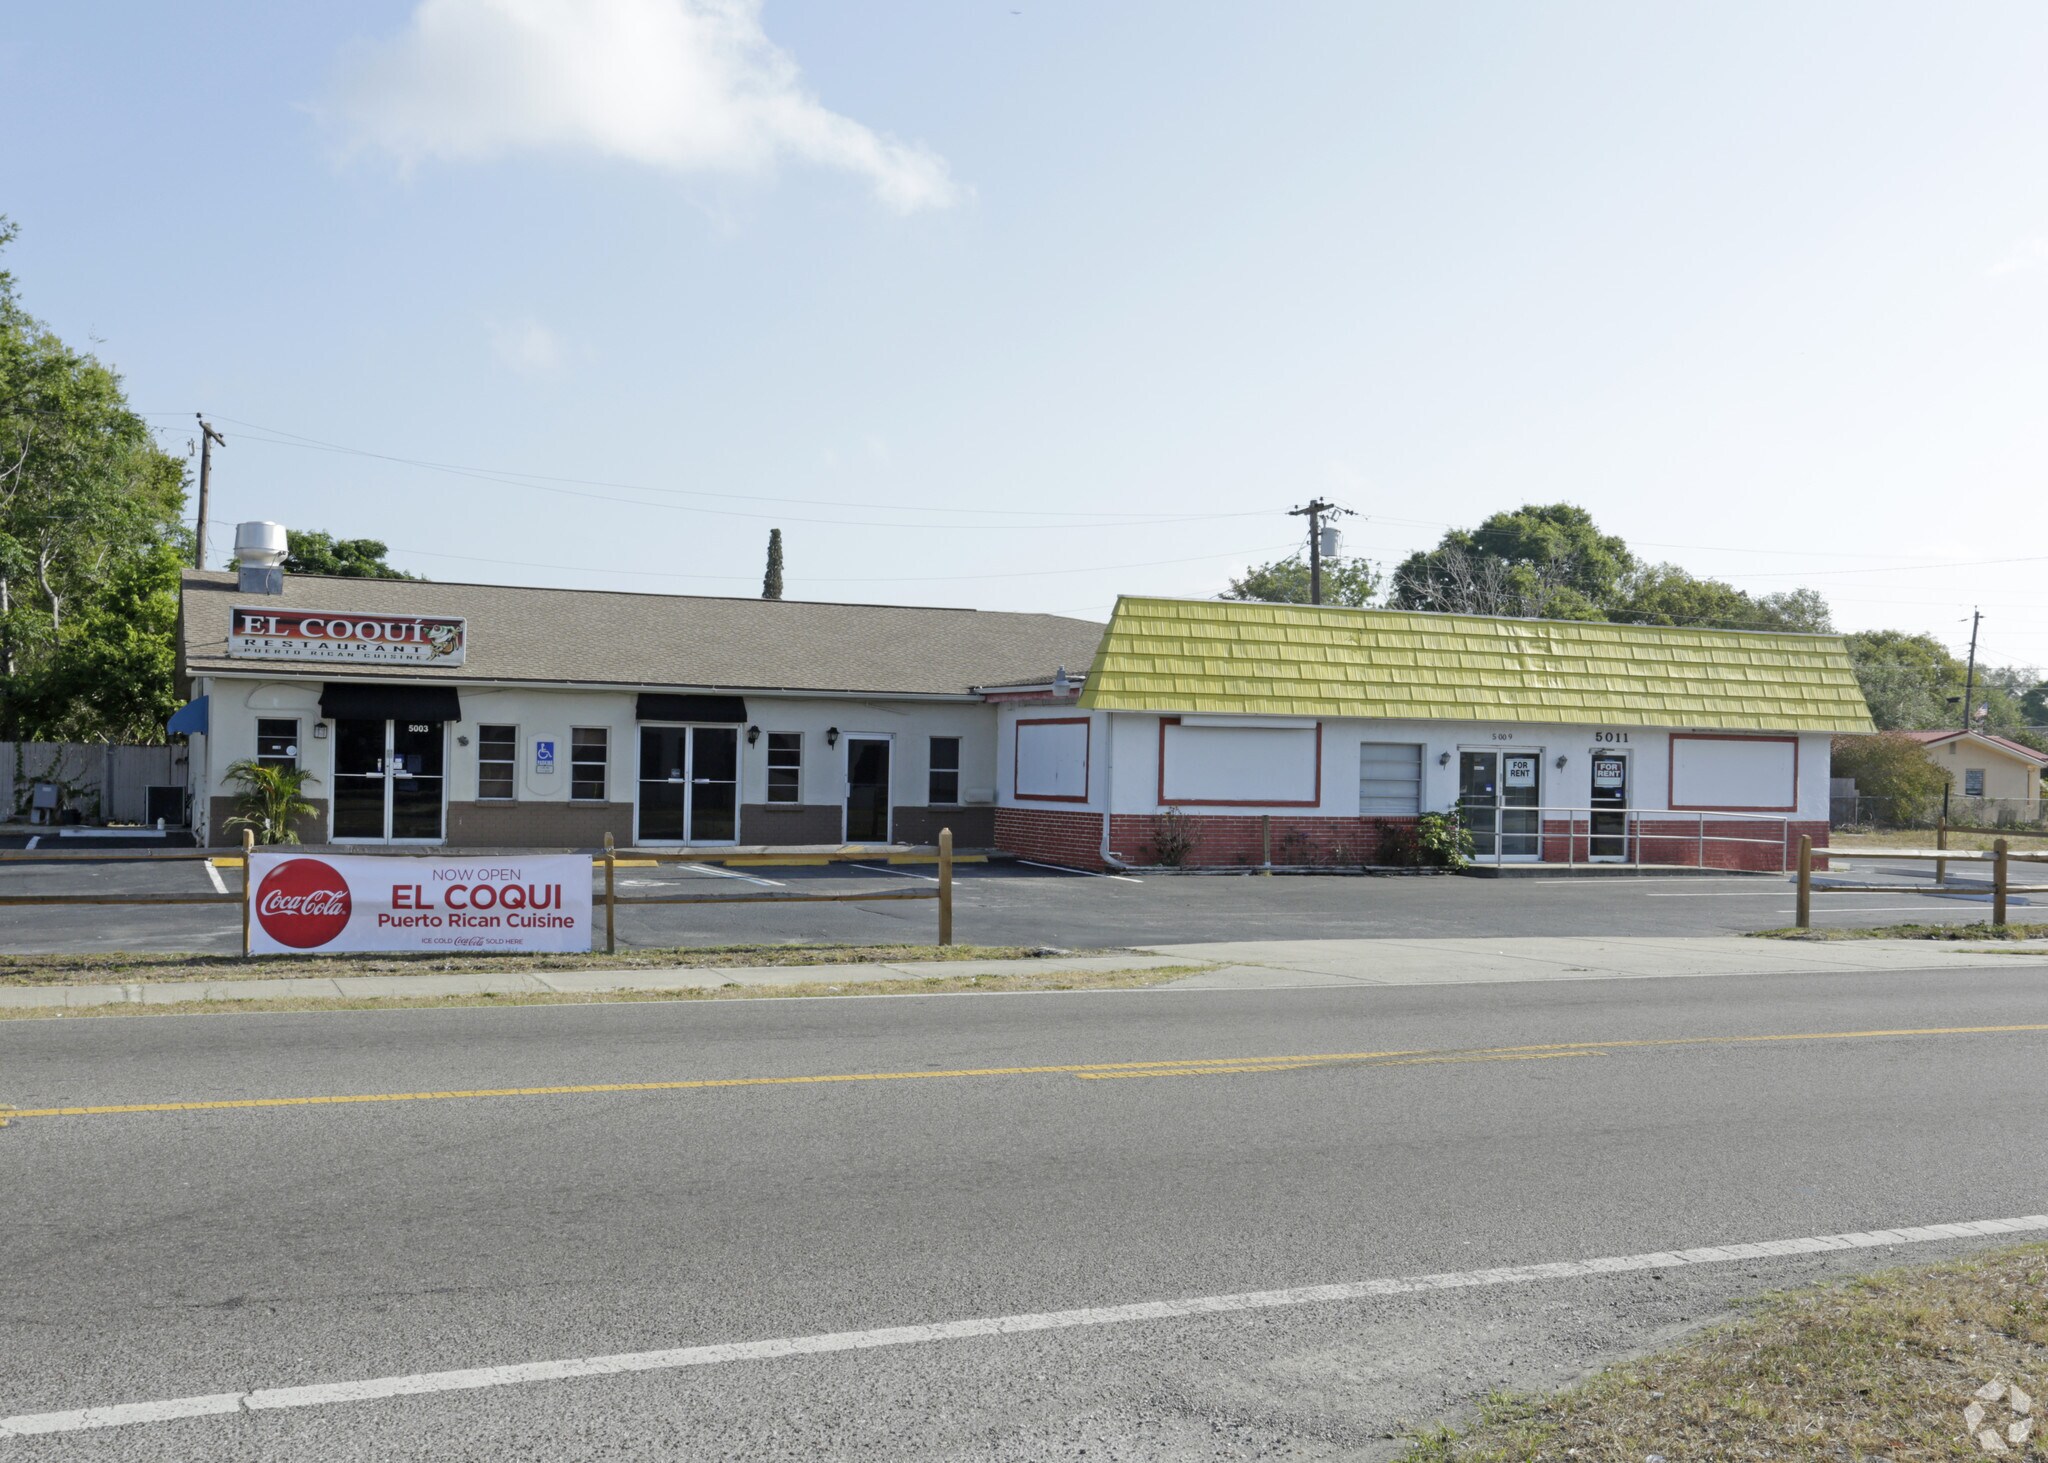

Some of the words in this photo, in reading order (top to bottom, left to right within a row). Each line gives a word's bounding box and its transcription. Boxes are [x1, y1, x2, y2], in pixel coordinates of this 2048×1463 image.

[241, 615, 289, 636] EL
[299, 618, 425, 645] COQUÍ
[244, 639, 422, 653] RESTAURANT
[408, 724, 429, 733] 5003
[1595, 732, 1628, 743] 5011
[432, 869, 474, 881] NOW
[477, 868, 521, 881] OPEN
[260, 889, 348, 916] Coca-Cola
[392, 884, 434, 910] EL
[444, 884, 561, 910] COQUI
[378, 913, 443, 928] Puerto
[448, 913, 501, 928] Rican
[506, 912, 575, 929] Cuisine
